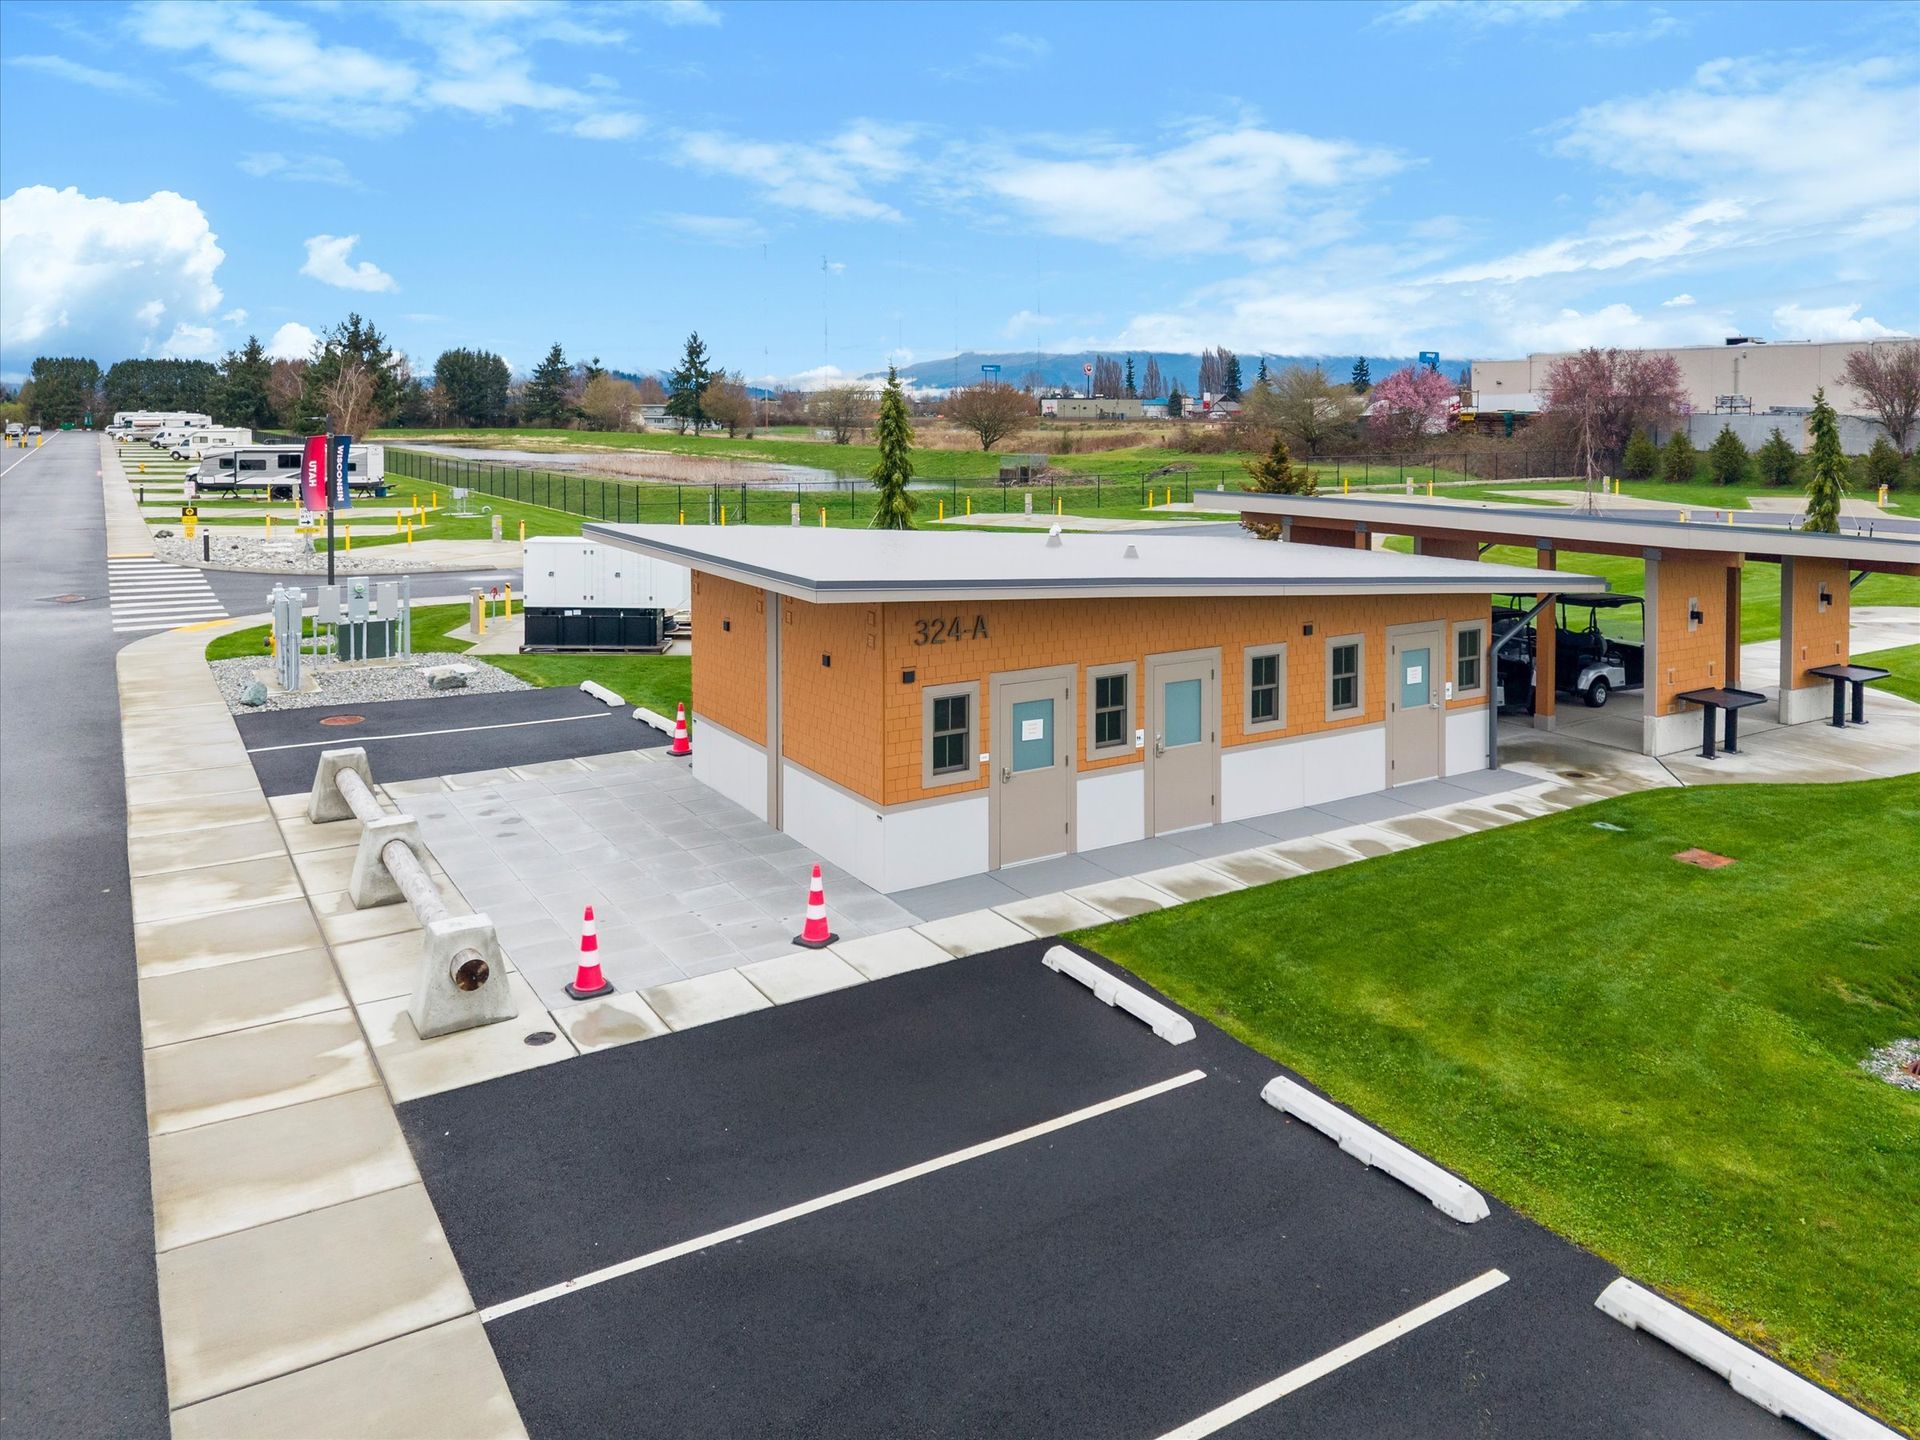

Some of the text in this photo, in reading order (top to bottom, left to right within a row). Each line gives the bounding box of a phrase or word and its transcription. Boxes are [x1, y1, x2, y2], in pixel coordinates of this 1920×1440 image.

[308, 460, 318, 487] UTAH
[336, 445, 345, 502] WISCONSIN
[914, 615, 989, 646] 324-A
